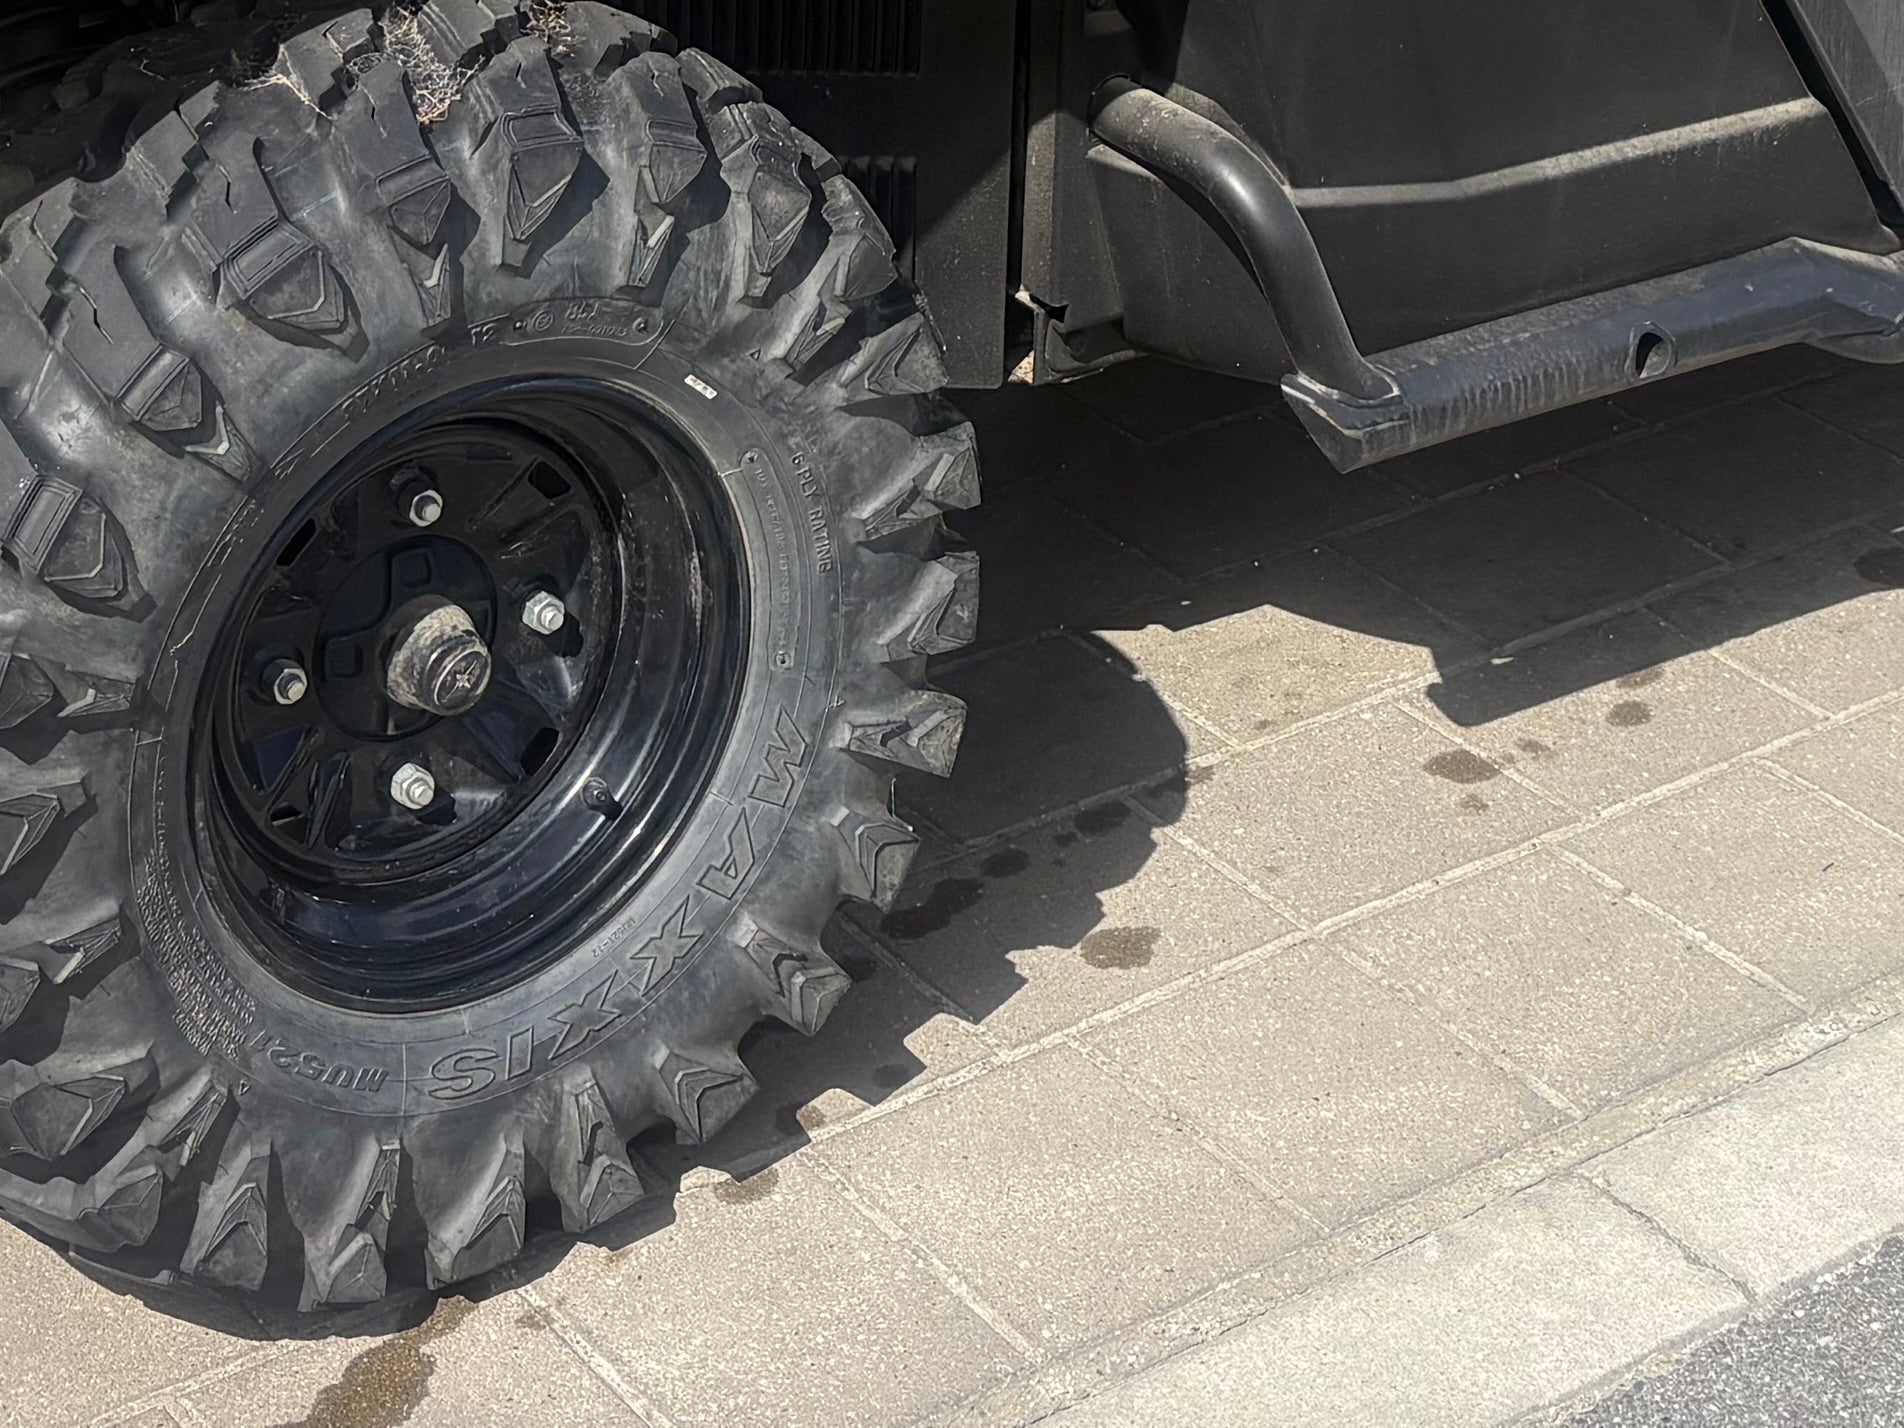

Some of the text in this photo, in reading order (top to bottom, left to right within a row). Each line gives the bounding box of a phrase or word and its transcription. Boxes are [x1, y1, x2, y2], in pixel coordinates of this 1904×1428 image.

[792, 451, 834, 575] 6 PLY RATING
[428, 706, 810, 1101] MAXXIS
